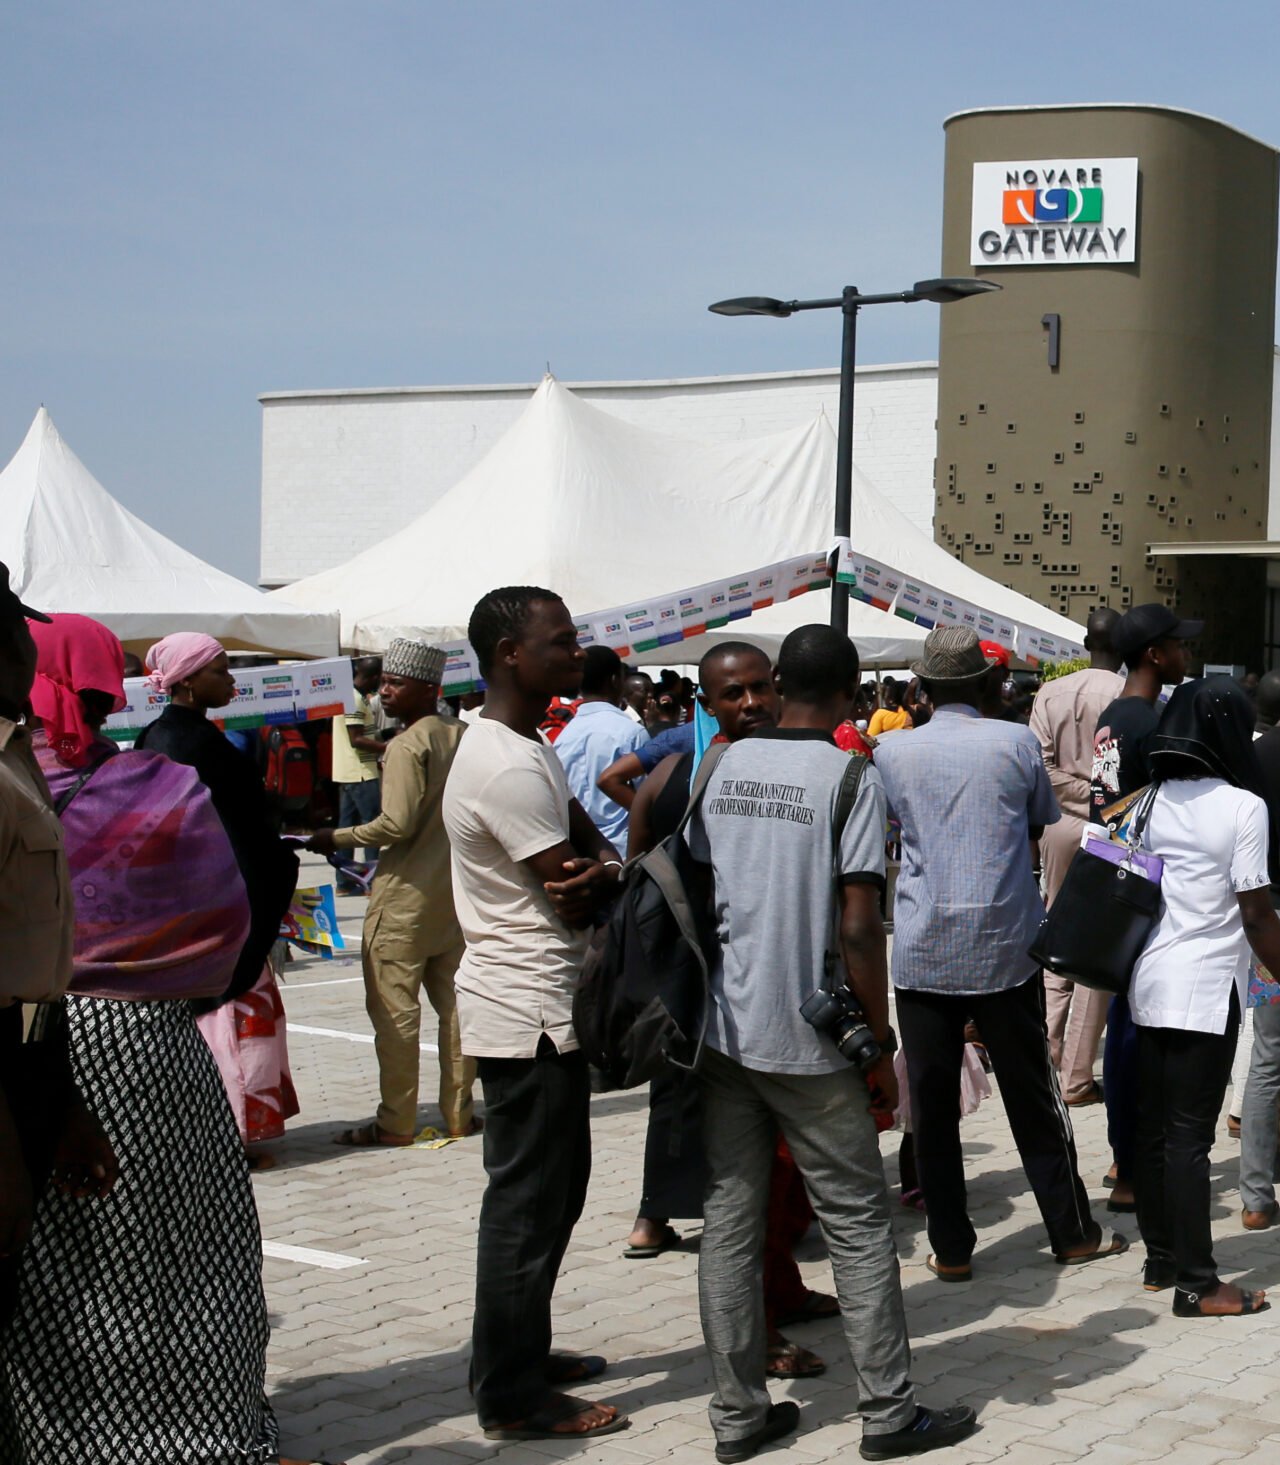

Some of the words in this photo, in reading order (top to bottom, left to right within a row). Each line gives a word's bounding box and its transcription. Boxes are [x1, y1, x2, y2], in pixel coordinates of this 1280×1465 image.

[1006, 167, 1102, 185] NOVARE
[978, 227, 1126, 256] GATEWAY
[720, 780, 735, 796] THE
[734, 780, 770, 799] NIGERIAN
[768, 783, 806, 803] INSTITUTE
[714, 798, 767, 817] PROFESSIONAL
[765, 801, 815, 825] SECRETARIES
